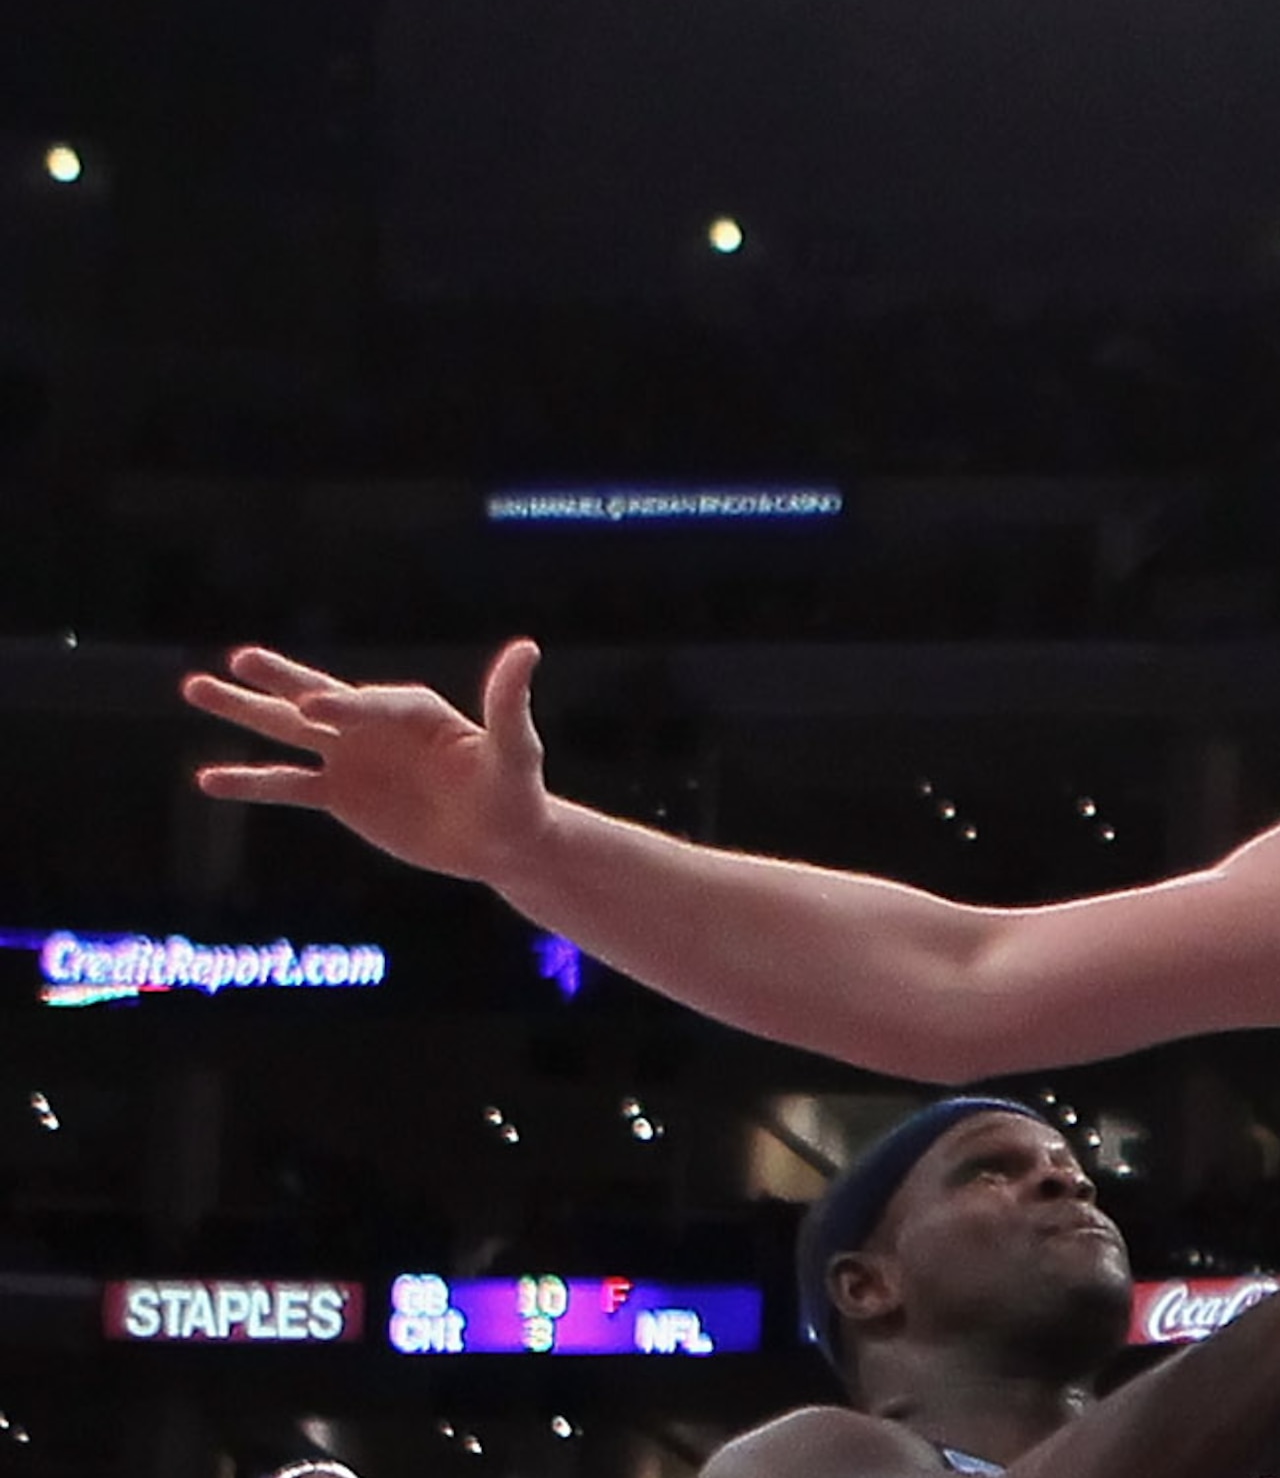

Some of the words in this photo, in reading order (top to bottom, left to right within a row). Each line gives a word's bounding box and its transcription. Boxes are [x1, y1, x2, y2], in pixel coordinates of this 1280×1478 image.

[40, 931, 387, 993] CreditReport.com
[124, 1283, 344, 1340] STAPLES
[517, 1274, 568, 1318] 10
[635, 1310, 714, 1353] NFL
